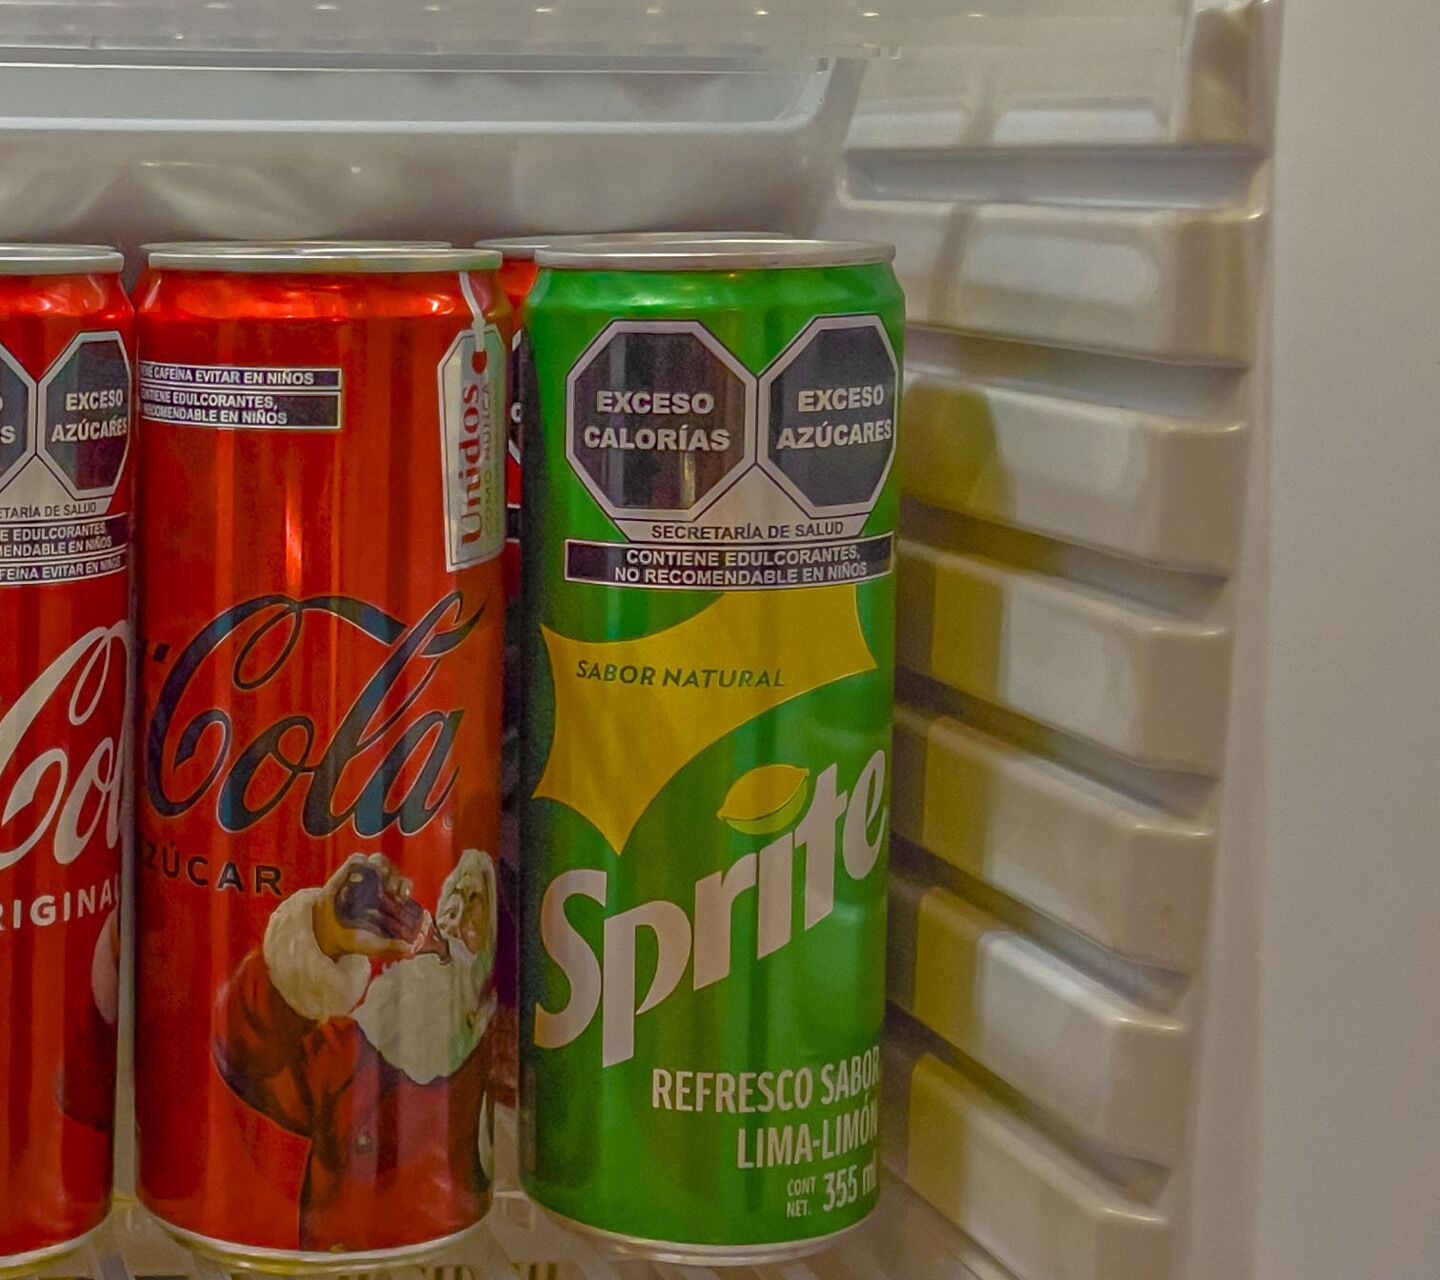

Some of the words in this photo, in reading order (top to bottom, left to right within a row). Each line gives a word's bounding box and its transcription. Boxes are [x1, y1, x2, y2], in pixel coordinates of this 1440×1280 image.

[195, 369, 241, 385] EVITAR
[243, 371, 263, 385] EN
[266, 369, 315, 386] NIÑOS
[65, 388, 124, 412] EXCESO
[596, 390, 714, 414] EXCESO
[798, 386, 885, 412] EXCESO
[51, 414, 128, 442] AZÚCARES
[220, 410, 241, 424] EN
[242, 409, 288, 425] NIÑOS
[584, 424, 730, 451] CALORÍAS
[775, 419, 893, 450] AZÚCARES
[458, 384, 484, 546] Unidos
[45, 504, 60, 516] DE
[63, 502, 97, 516] SALUD
[651, 523, 760, 541] SECRETARÍA
[767, 524, 789, 539] DE
[795, 521, 844, 537] SALUD
[67, 541, 84, 554] EN
[626, 549, 719, 567] CONTIENE
[41, 560, 85, 580] EVITAR
[85, 559, 100, 575] EN
[614, 566, 640, 582] NO
[645, 567, 798, 586] RECOMENDABLE
[801, 567, 824, 582] EN
[826, 560, 868, 581] NIÑOS
[576, 659, 656, 686] SABOR
[662, 667, 786, 688] NATURAL
[533, 749, 888, 1068] Sprite
[651, 1067, 814, 1114] REFRESCO
[820, 1045, 880, 1105] SABOR
[736, 1093, 878, 1170] LIMA-LIMÓN
[786, 1175, 817, 1198] CONT
[822, 1164, 858, 1212] 355
[786, 1199, 812, 1219] NET.
